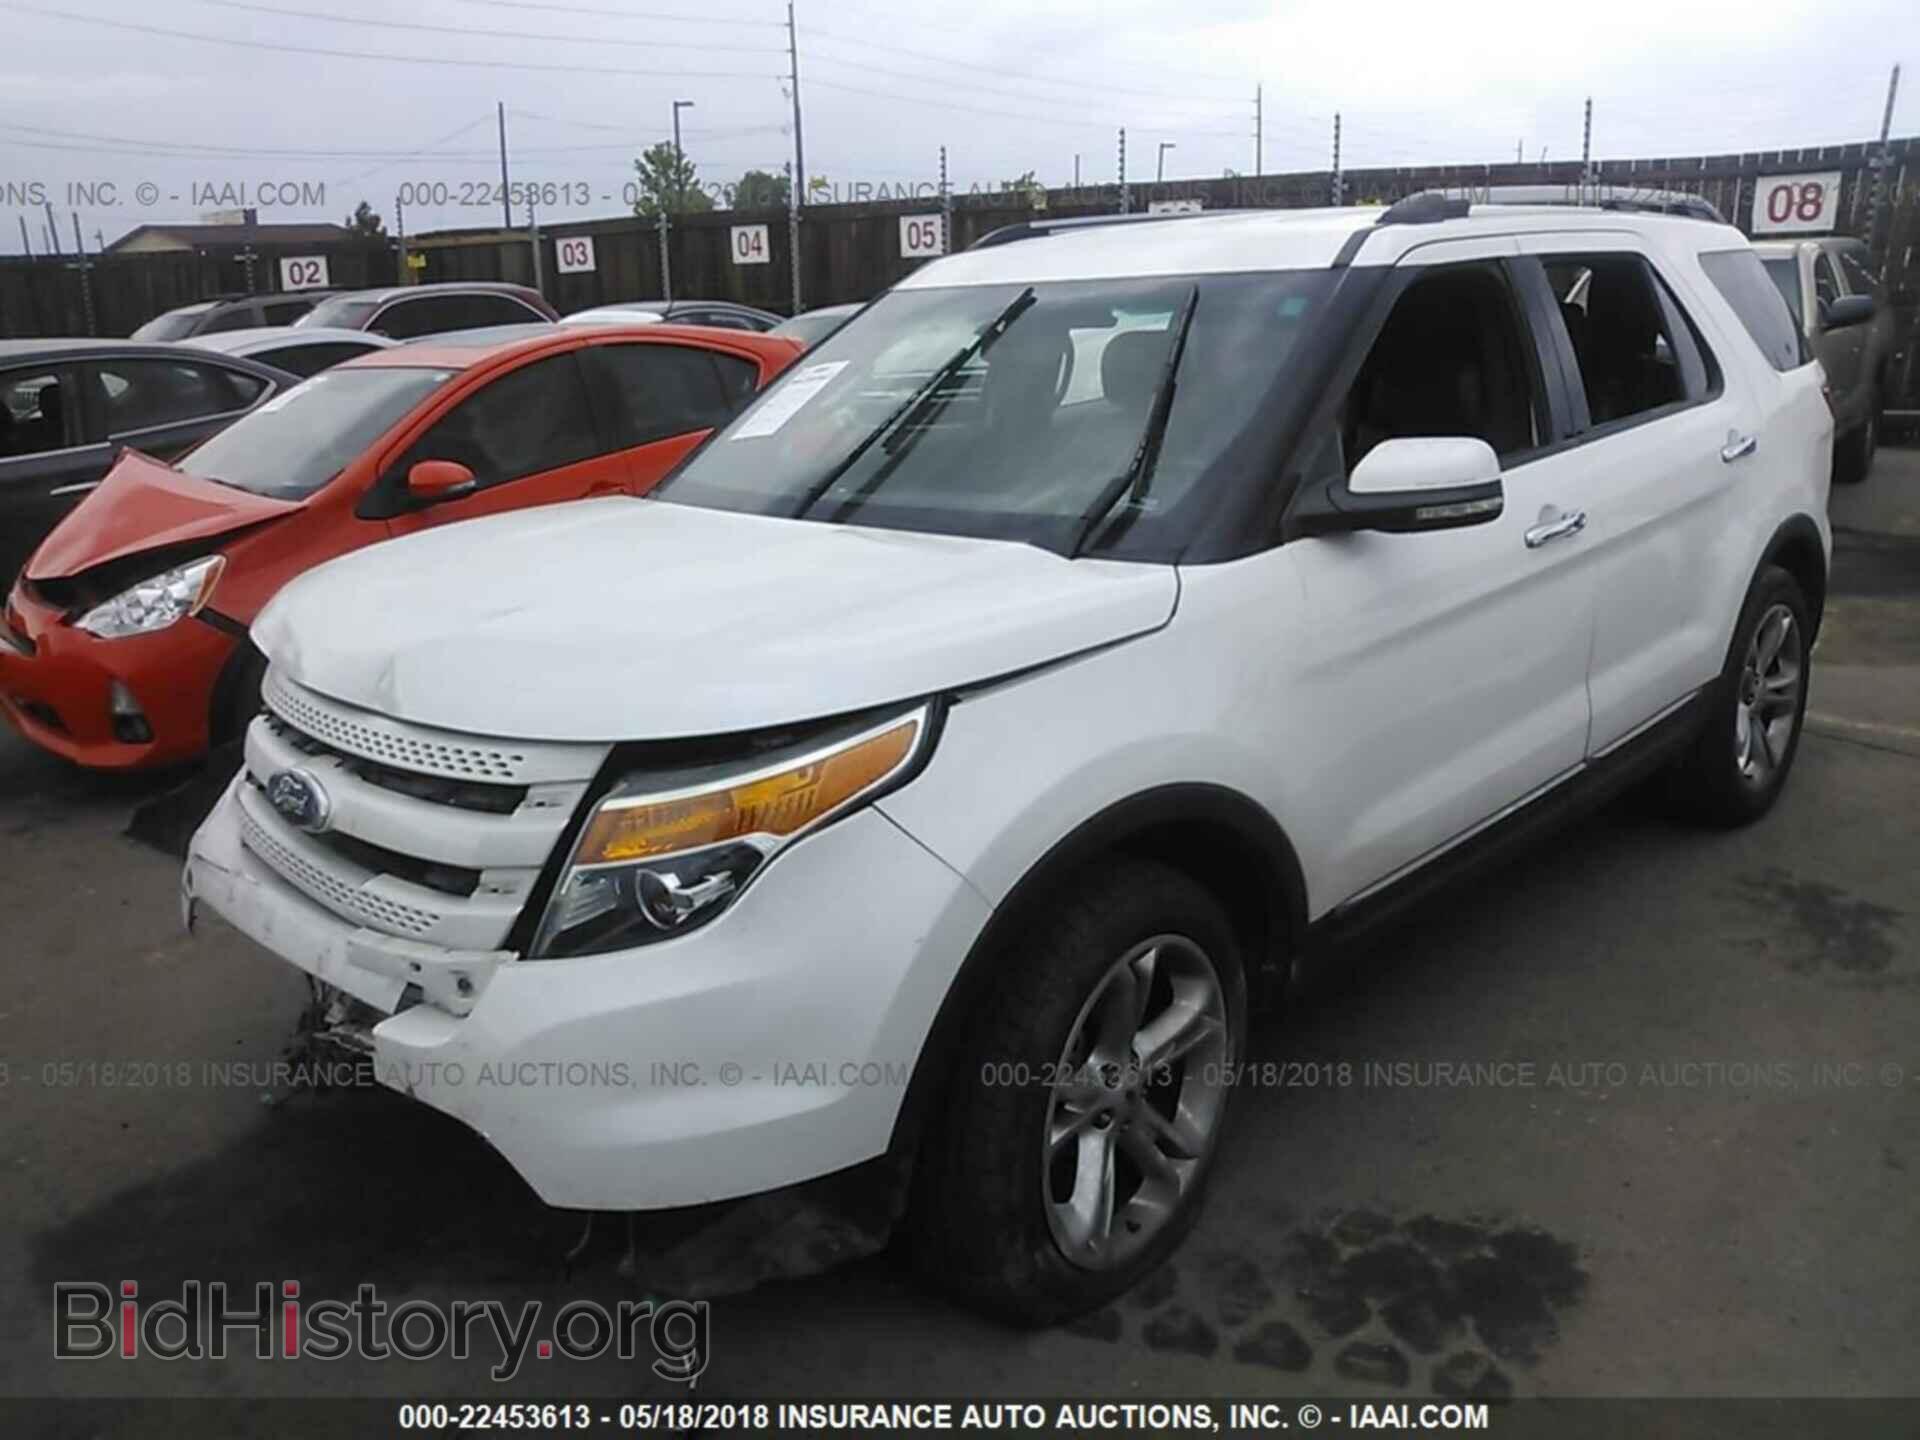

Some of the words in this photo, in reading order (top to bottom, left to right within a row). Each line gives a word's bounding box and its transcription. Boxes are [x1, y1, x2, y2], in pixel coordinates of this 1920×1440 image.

[1767, 182, 1823, 223] 08
[737, 232, 763, 257] 04
[907, 220, 936, 250] 05
[563, 239, 588, 266] 03
[289, 261, 321, 285] 02
